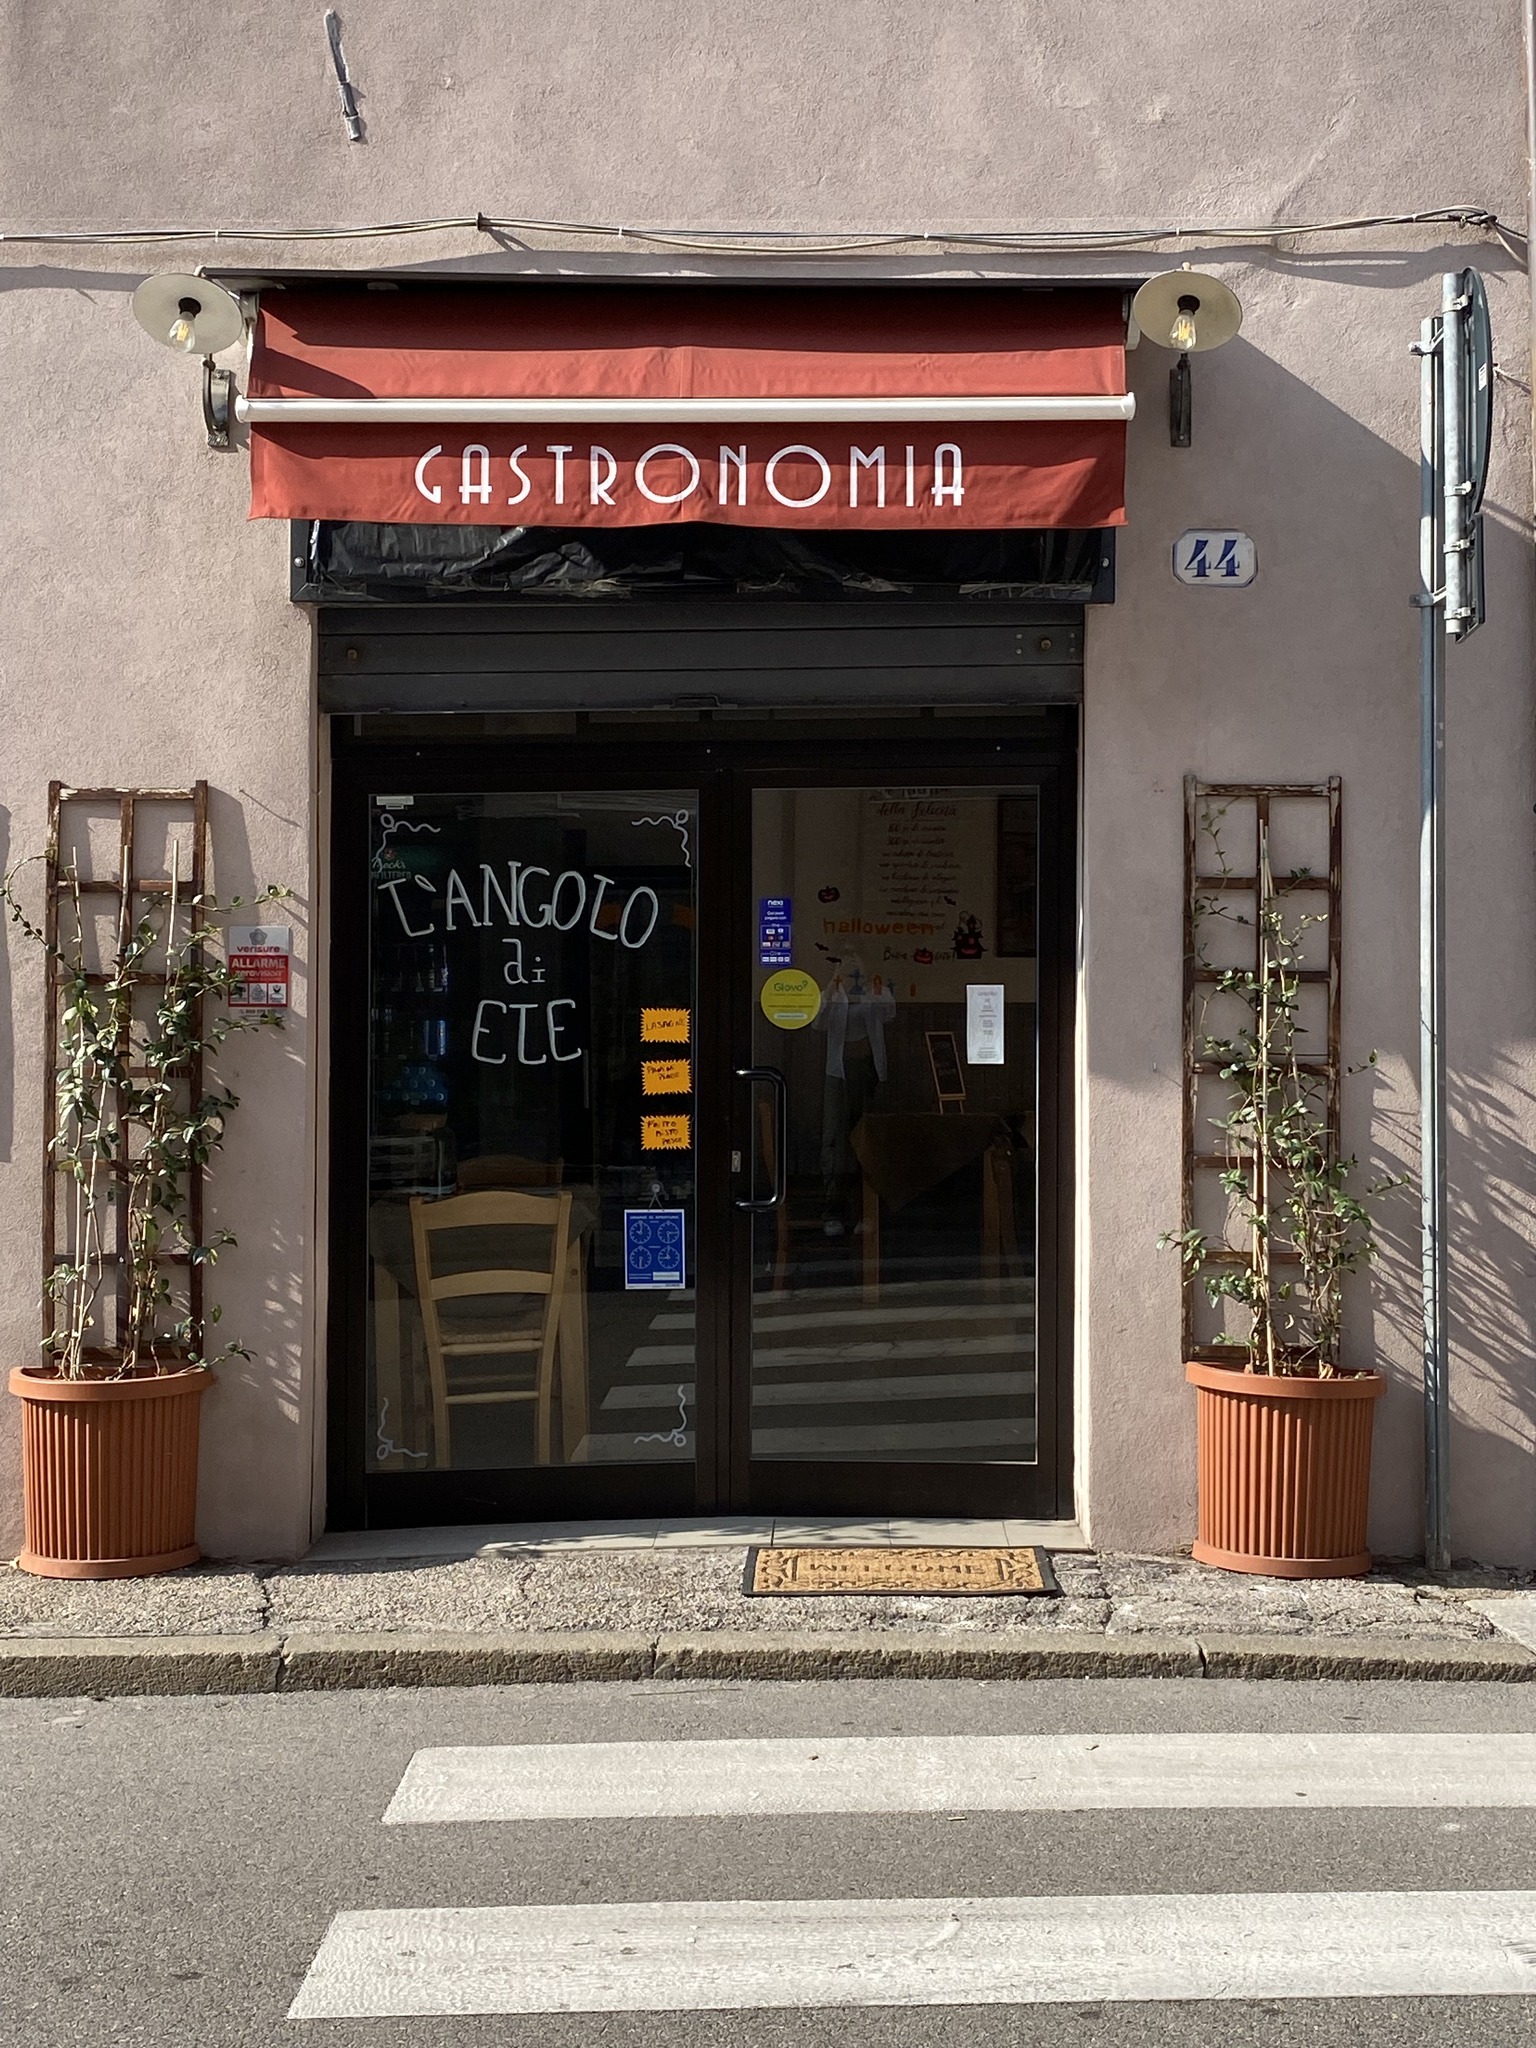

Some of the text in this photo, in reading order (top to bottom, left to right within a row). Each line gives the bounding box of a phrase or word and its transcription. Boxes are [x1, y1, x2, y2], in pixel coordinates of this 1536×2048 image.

[414, 442, 965, 508] GASTRONOMIA
[1184, 539, 1240, 578] 44
[378, 861, 659, 948] L'ANGOLO
[823, 918, 934, 935] halloween
[231, 957, 286, 969] ALLARME
[236, 945, 280, 953] verisure
[502, 938, 546, 985] di
